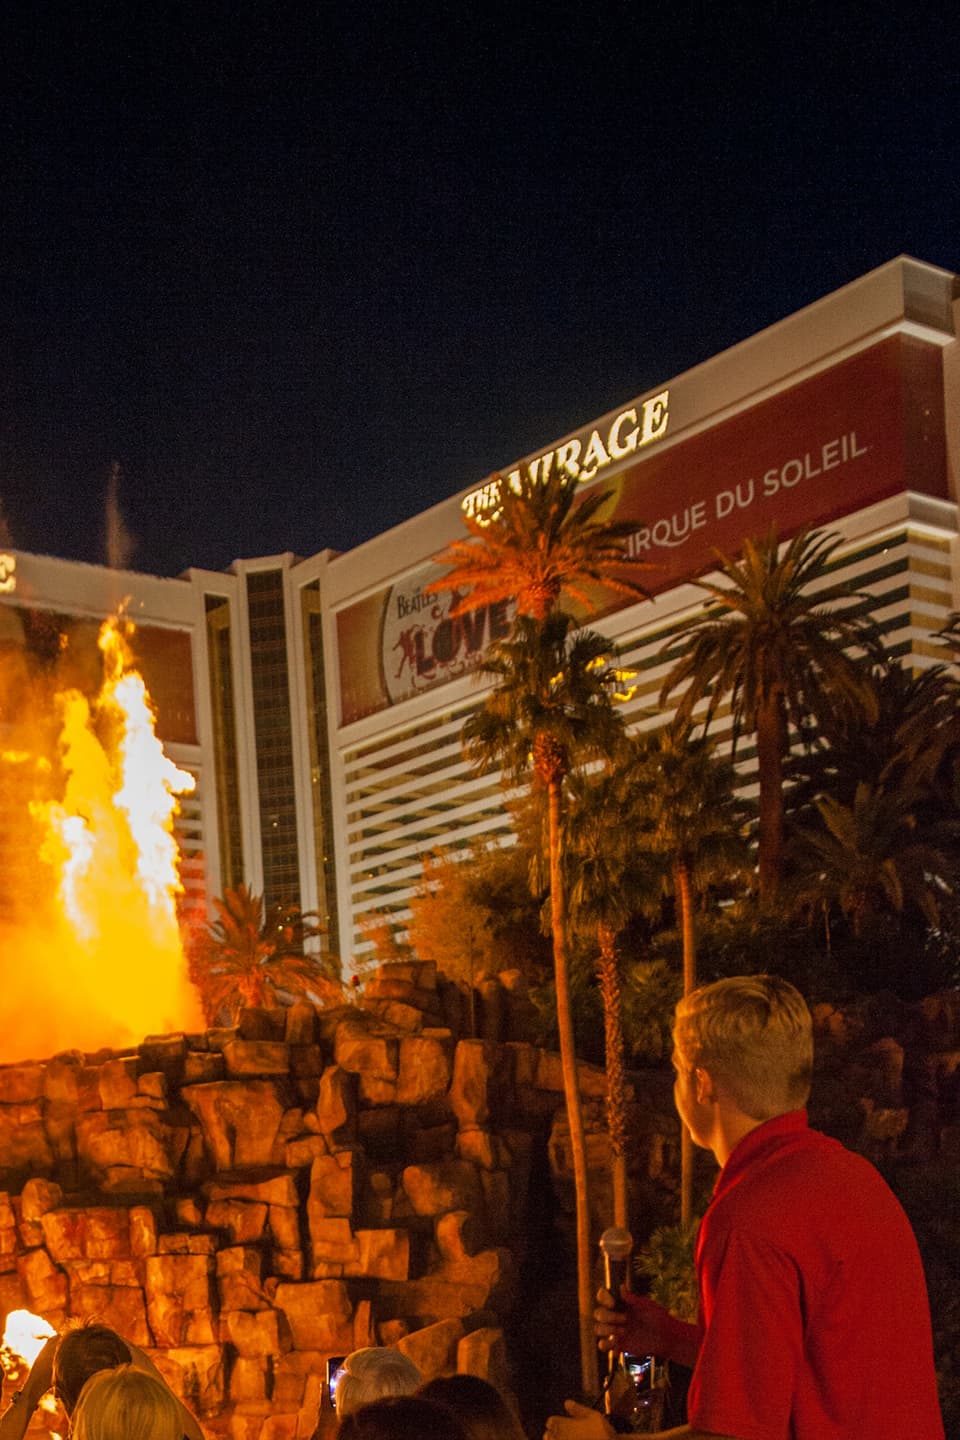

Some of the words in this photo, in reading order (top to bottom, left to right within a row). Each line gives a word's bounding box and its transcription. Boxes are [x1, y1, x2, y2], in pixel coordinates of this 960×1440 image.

[623, 502, 707, 559] IRQUE
[716, 480, 755, 519] DU
[763, 432, 868, 497] SOLEIL
